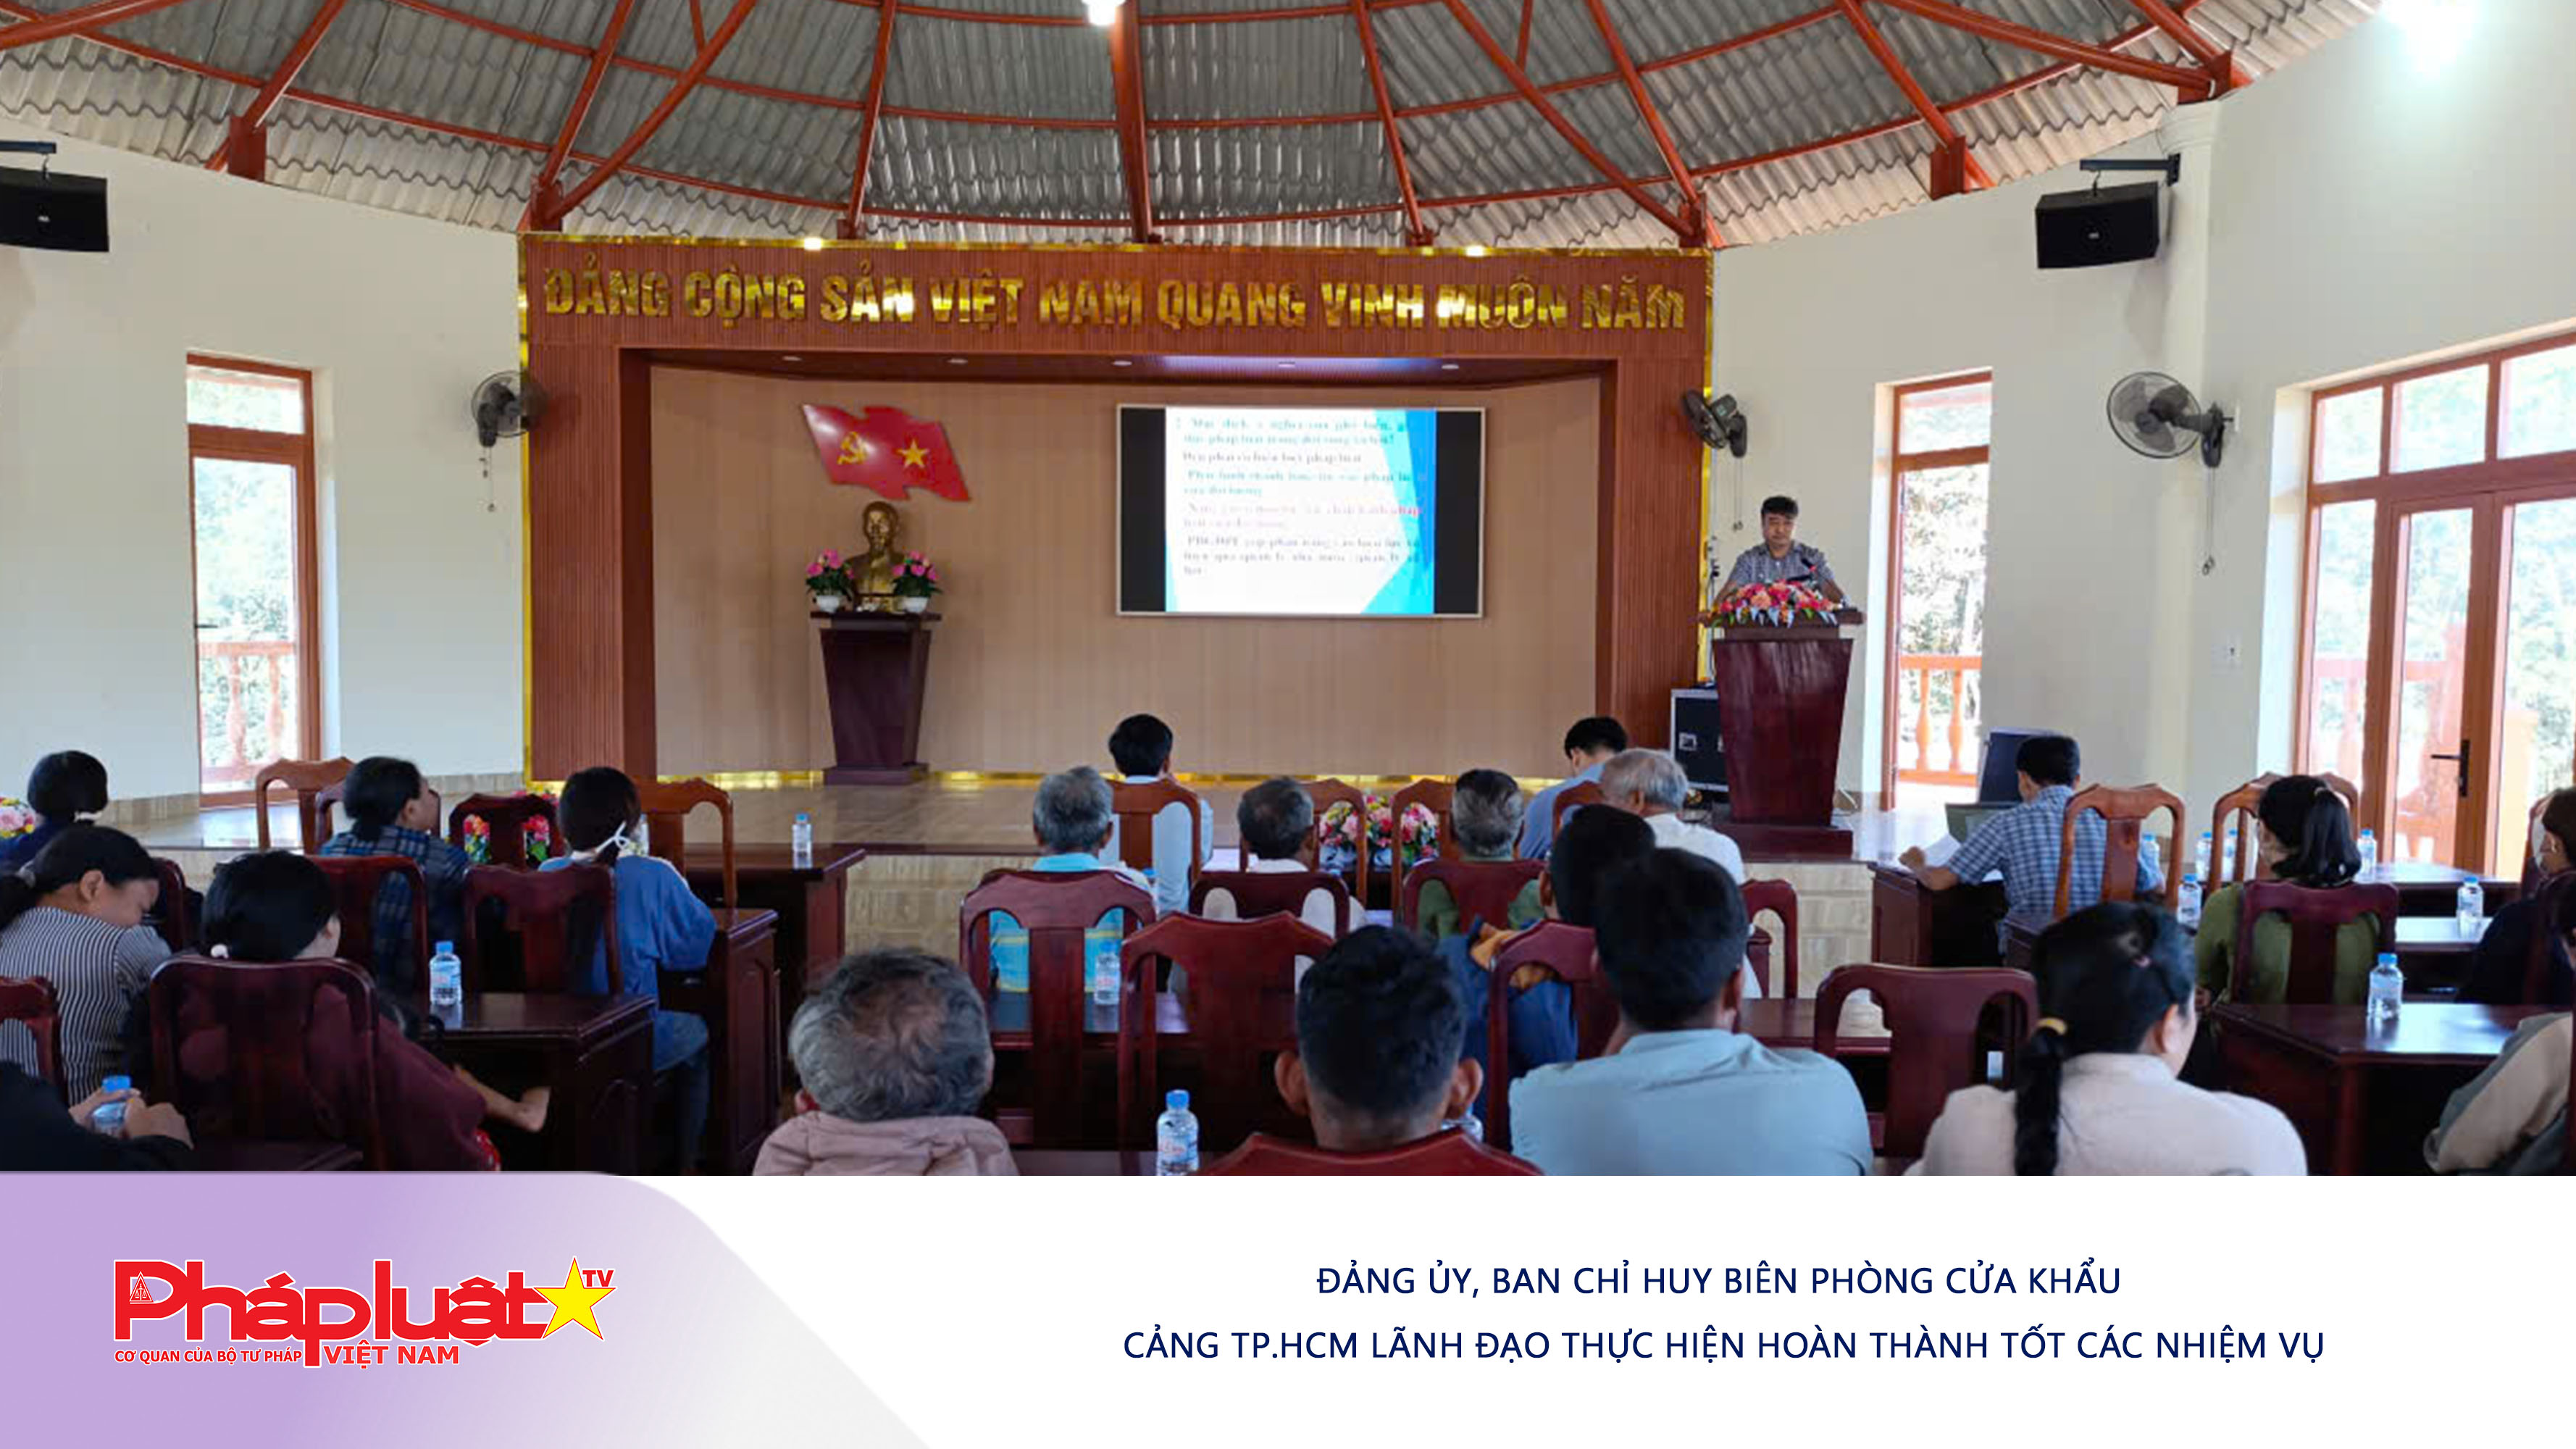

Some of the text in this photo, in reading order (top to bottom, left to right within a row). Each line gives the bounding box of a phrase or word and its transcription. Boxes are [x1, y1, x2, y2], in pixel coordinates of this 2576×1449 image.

[544, 253, 1684, 331] ĐẢNG CỘNG SẢN VIỆT NAM QUANG VINH MUÔN NĂM
